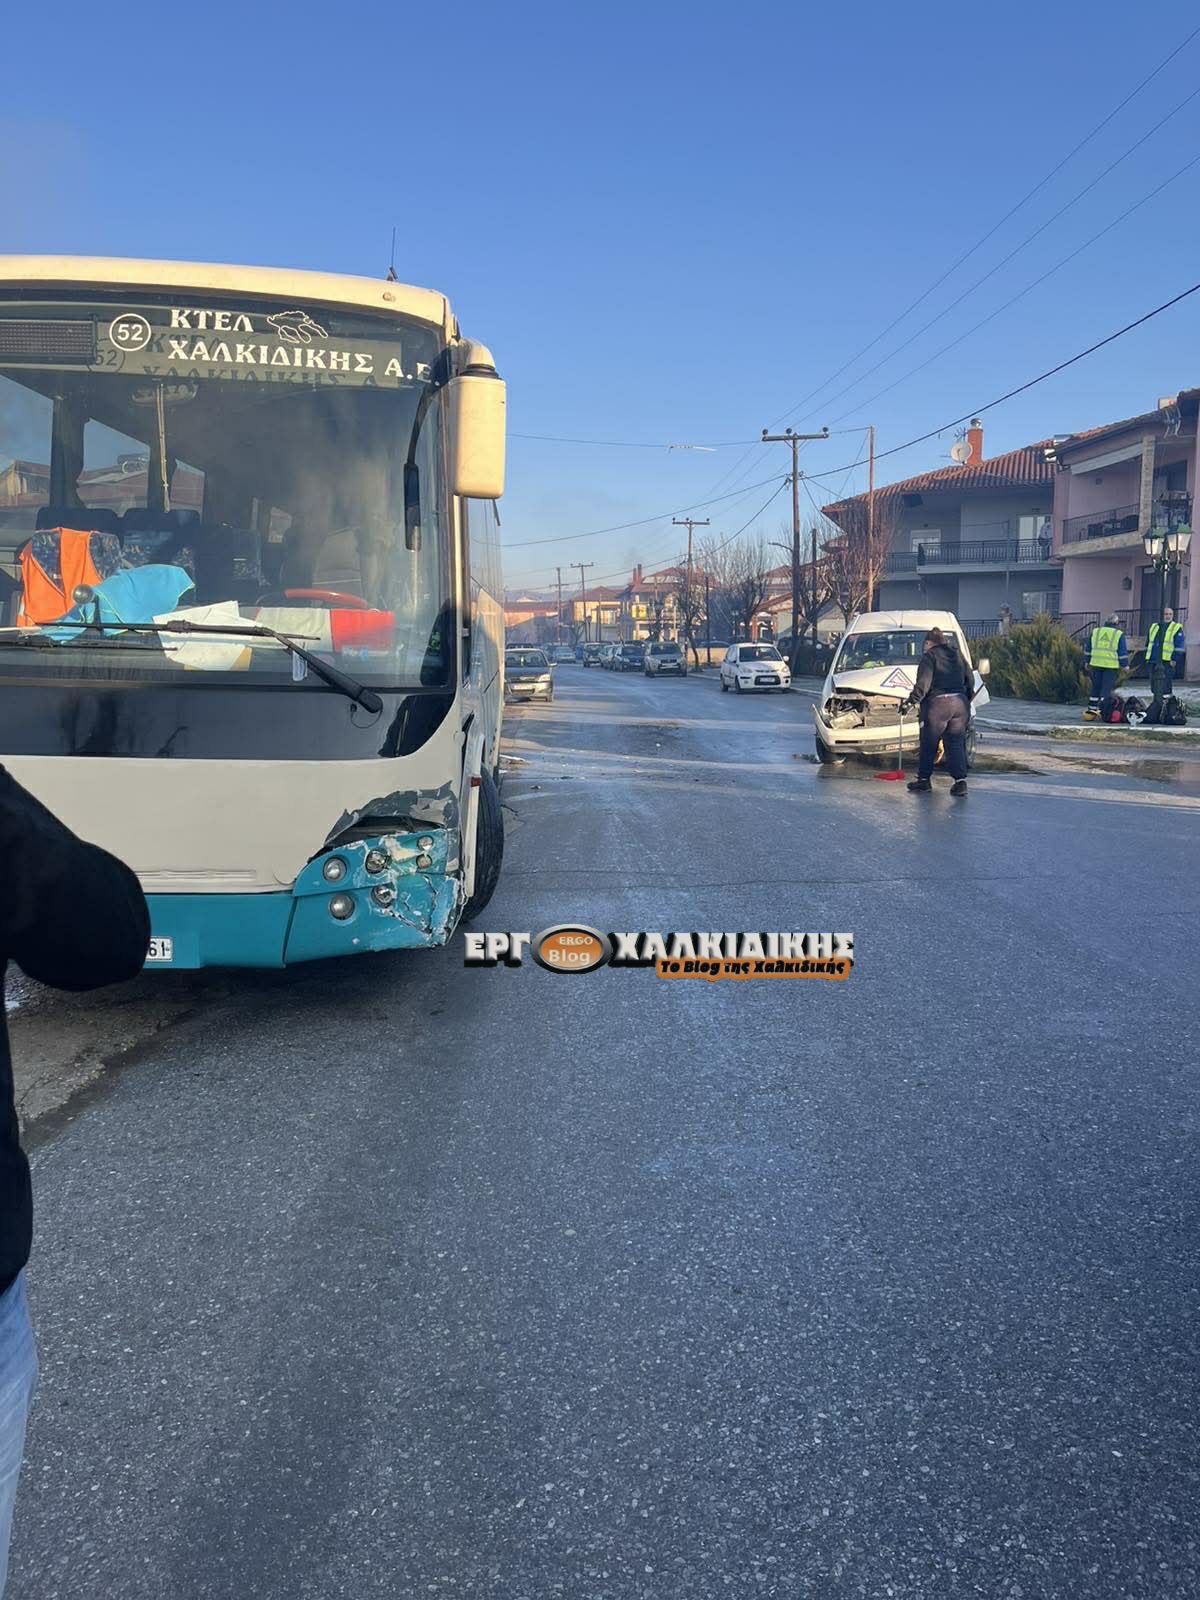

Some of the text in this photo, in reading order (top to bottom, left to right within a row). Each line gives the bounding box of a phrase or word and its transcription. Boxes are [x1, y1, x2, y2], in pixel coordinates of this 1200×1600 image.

[170, 309, 254, 332] ΚΤΕΛ
[117, 323, 143, 341] 52
[168, 339, 374, 373] ΧΑΛΚΙΔΙΚΗΣ
[149, 940, 165, 957] 61
